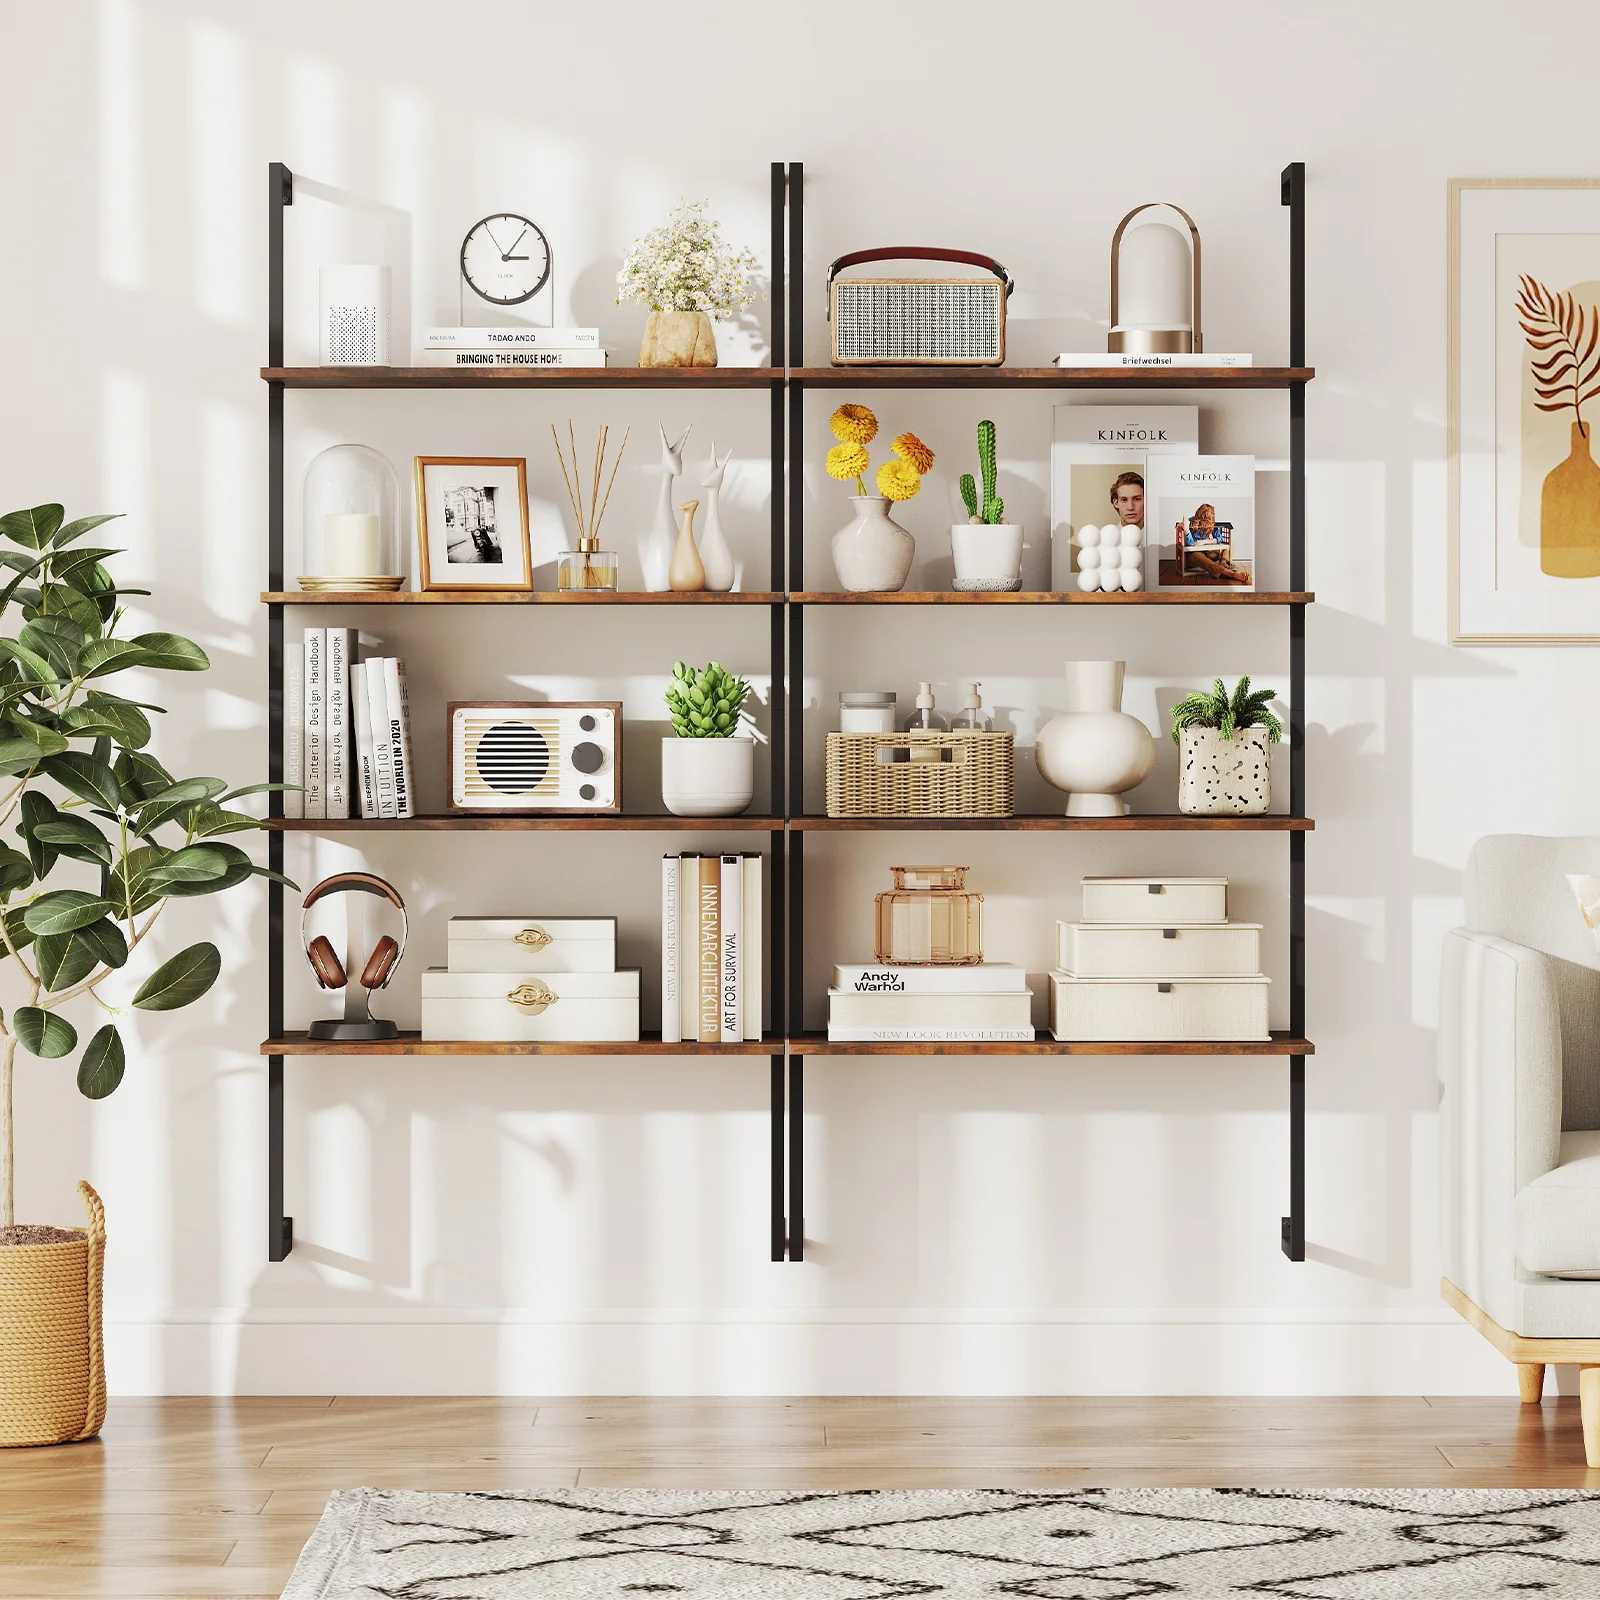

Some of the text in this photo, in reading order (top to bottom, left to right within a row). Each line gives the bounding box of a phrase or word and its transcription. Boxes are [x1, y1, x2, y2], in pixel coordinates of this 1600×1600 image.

[488, 334, 536, 342] TADAO ANDO
[456, 354, 562, 364] BRINGING THE HOUSE HOME
[1122, 356, 1172, 365] Briefwechsel
[1098, 430, 1168, 441] KINFOLK
[1180, 473, 1232, 481] KINFOLK
[310, 635, 321, 803] The Interior Design Handbook
[290, 667, 299, 791] OUSEHOLD DECORATES
[390, 719, 408, 814] THE WORLD IN 2020
[376, 743, 393, 814] INTUITION
[667, 867, 676, 1001] NEW LOOK REVOLUTION
[701, 885, 718, 1033] INNENARCHITEKTUR
[724, 932, 737, 1032] ART FOR SURVIVAL
[860, 972, 899, 984] Andy
[854, 981, 905, 992] Warhol
[872, 1031, 1030, 1039] NEW LOOK REVOLUTION
